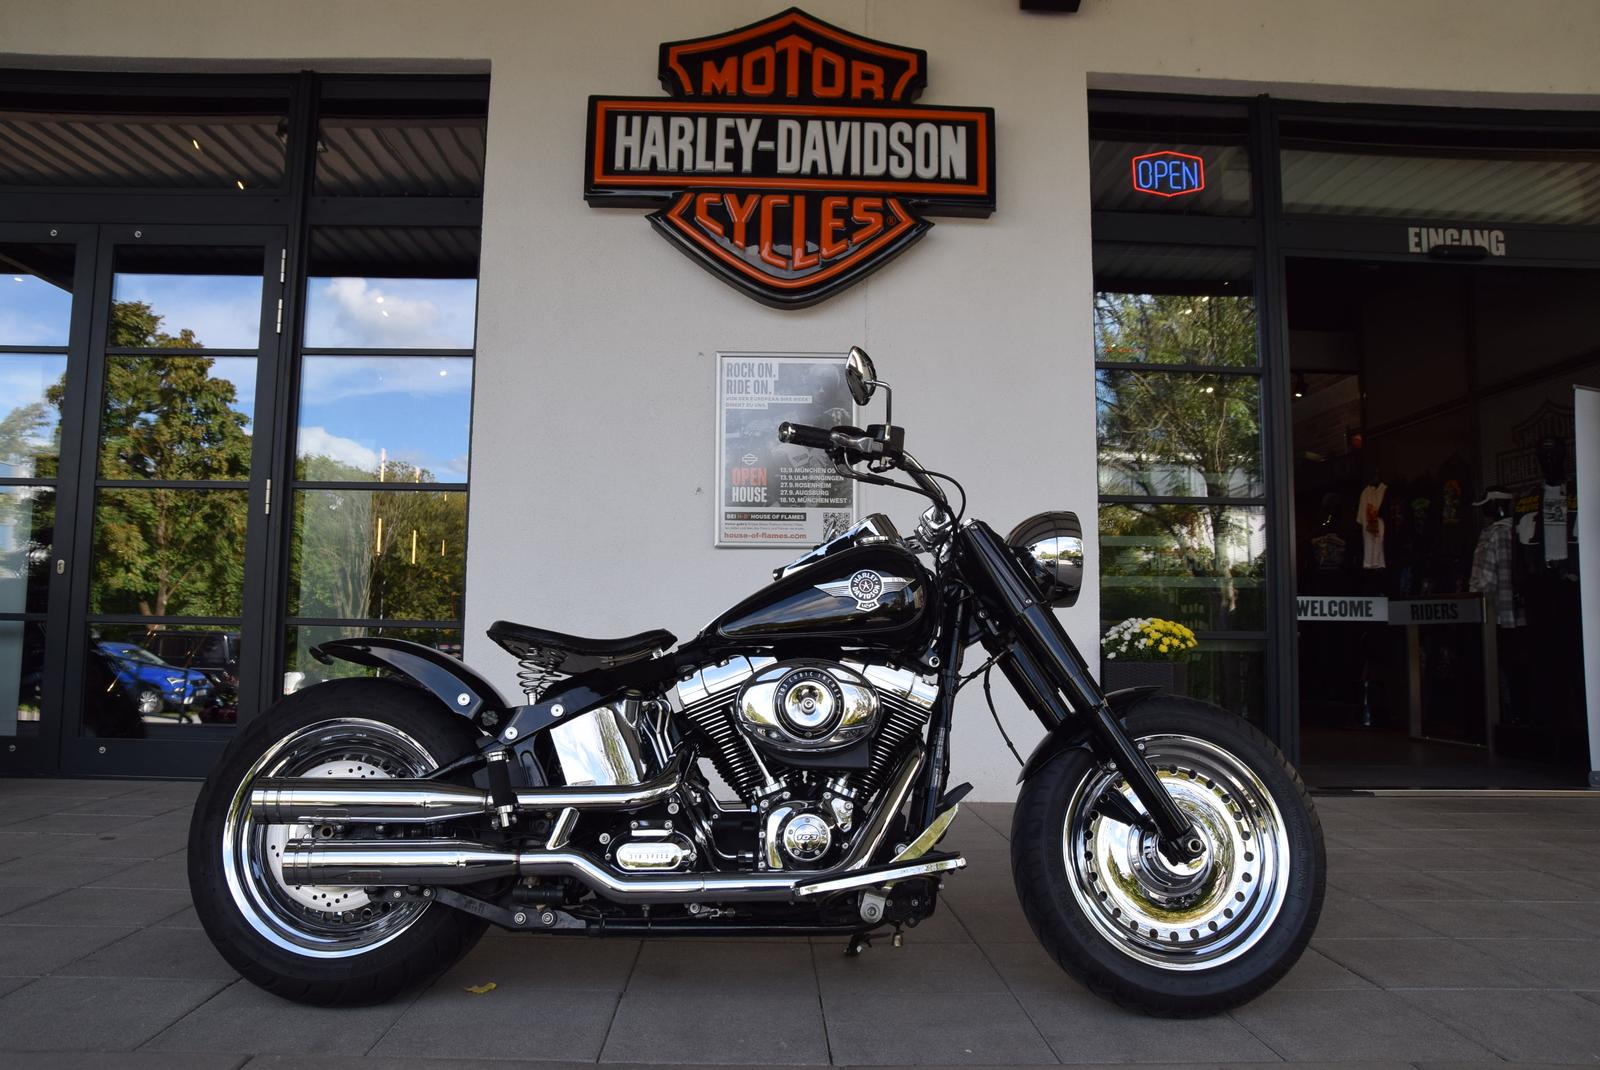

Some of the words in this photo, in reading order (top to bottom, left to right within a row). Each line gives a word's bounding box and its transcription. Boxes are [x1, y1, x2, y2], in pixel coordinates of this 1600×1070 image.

[702, 34, 886, 100] MOTOR
[613, 114, 968, 181] HARLEY-DAVIDSON
[1138, 160, 1198, 190] OPEN
[696, 193, 884, 270] CYCLES
[1408, 226, 1506, 256] EINGANG
[726, 362, 755, 378] ROCK
[757, 362, 776, 378] ON.
[726, 379, 751, 395] RIDE
[753, 379, 772, 395] ON.
[732, 467, 768, 486] OPEN
[732, 486, 767, 503] HOUSE
[853, 572, 879, 584] HARLEY
[852, 584, 881, 600] DAVIDSON
[1296, 599, 1373, 617] WELCOME
[1410, 603, 1459, 621] RIDERS
